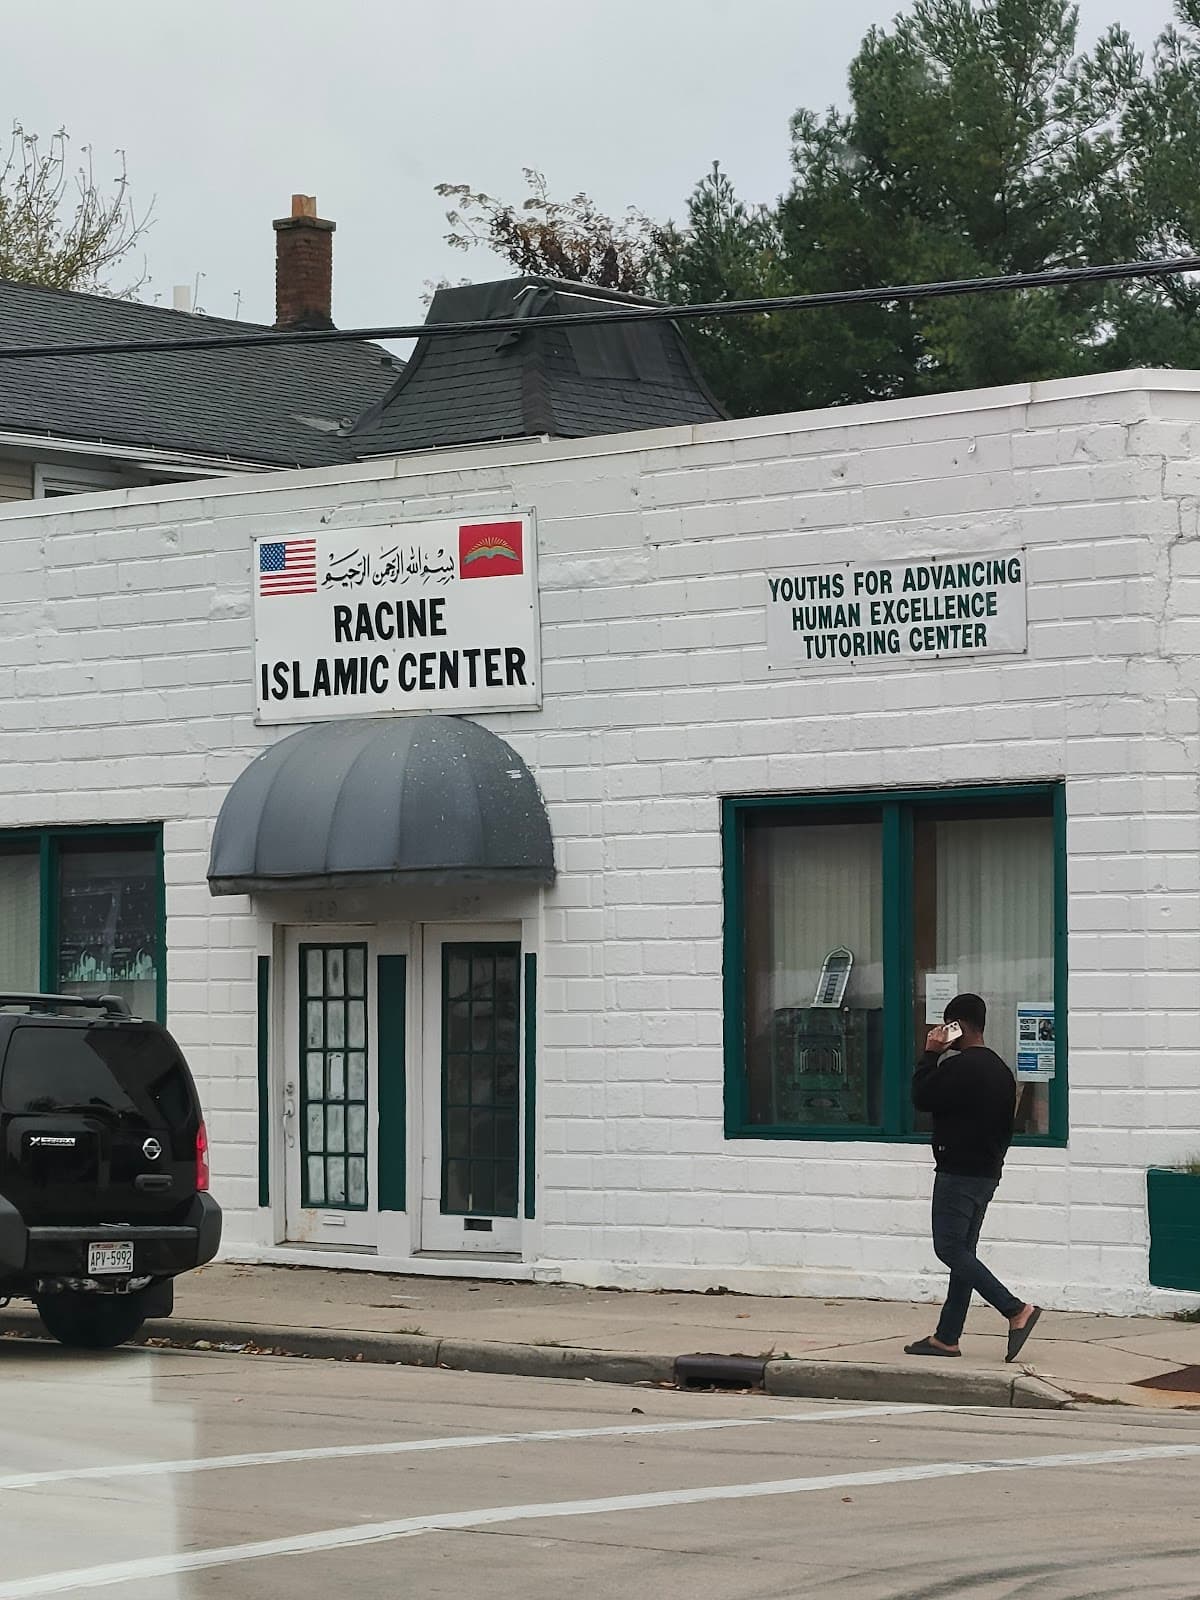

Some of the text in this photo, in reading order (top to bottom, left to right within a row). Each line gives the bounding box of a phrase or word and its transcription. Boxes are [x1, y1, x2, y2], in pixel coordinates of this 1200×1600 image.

[768, 557, 1022, 602] YOUTHS FOR ADVANCING
[333, 597, 447, 643] RACINE
[792, 591, 998, 631] HUMAN EXCELLENCE
[803, 623, 988, 660] TUTORING CENTER
[261, 647, 527, 700] ISLAMIC CENTER
[90, 1250, 132, 1267] APV-5992
